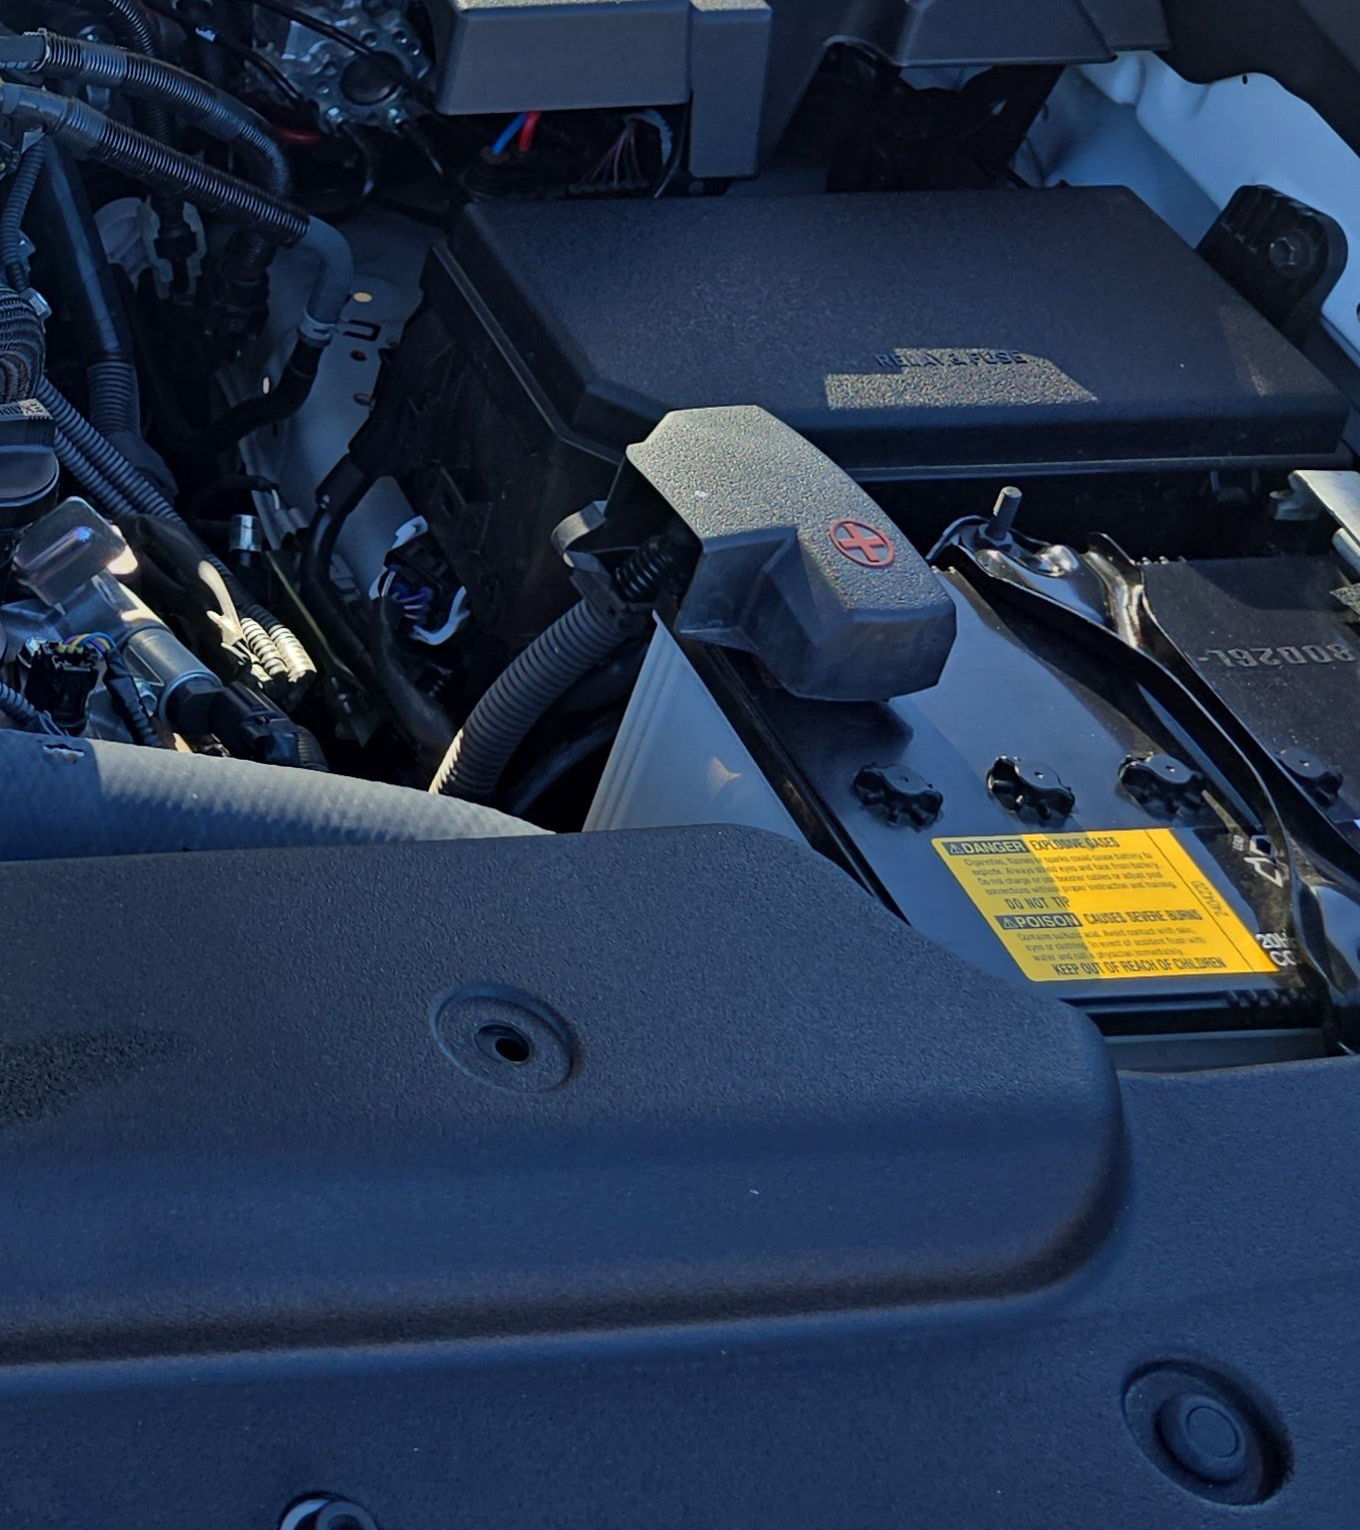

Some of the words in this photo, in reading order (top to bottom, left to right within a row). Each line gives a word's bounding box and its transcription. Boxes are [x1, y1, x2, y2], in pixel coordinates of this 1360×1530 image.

[876, 352, 944, 367] RELAY
[967, 349, 1028, 366] FUSE
[961, 840, 1027, 854] DANGER
[1029, 837, 1086, 851] EXPLOSIVE
[1085, 836, 1121, 850] GASES
[1004, 897, 1025, 910] DO
[1025, 896, 1050, 909] NOT
[1051, 895, 1072, 908] TIP
[1015, 913, 1081, 928] POISON
[1083, 911, 1128, 925] CAUSES
[1125, 909, 1168, 923] SEVERE
[1165, 908, 1203, 921] BURNS
[1051, 963, 1080, 976] KEEP
[1080, 961, 1105, 975] OUT
[1103, 960, 1121, 973] OF
[1120, 958, 1160, 972] REACH
[1157, 958, 1174, 971] OF
[1172, 956, 1227, 970] CHILDREN
